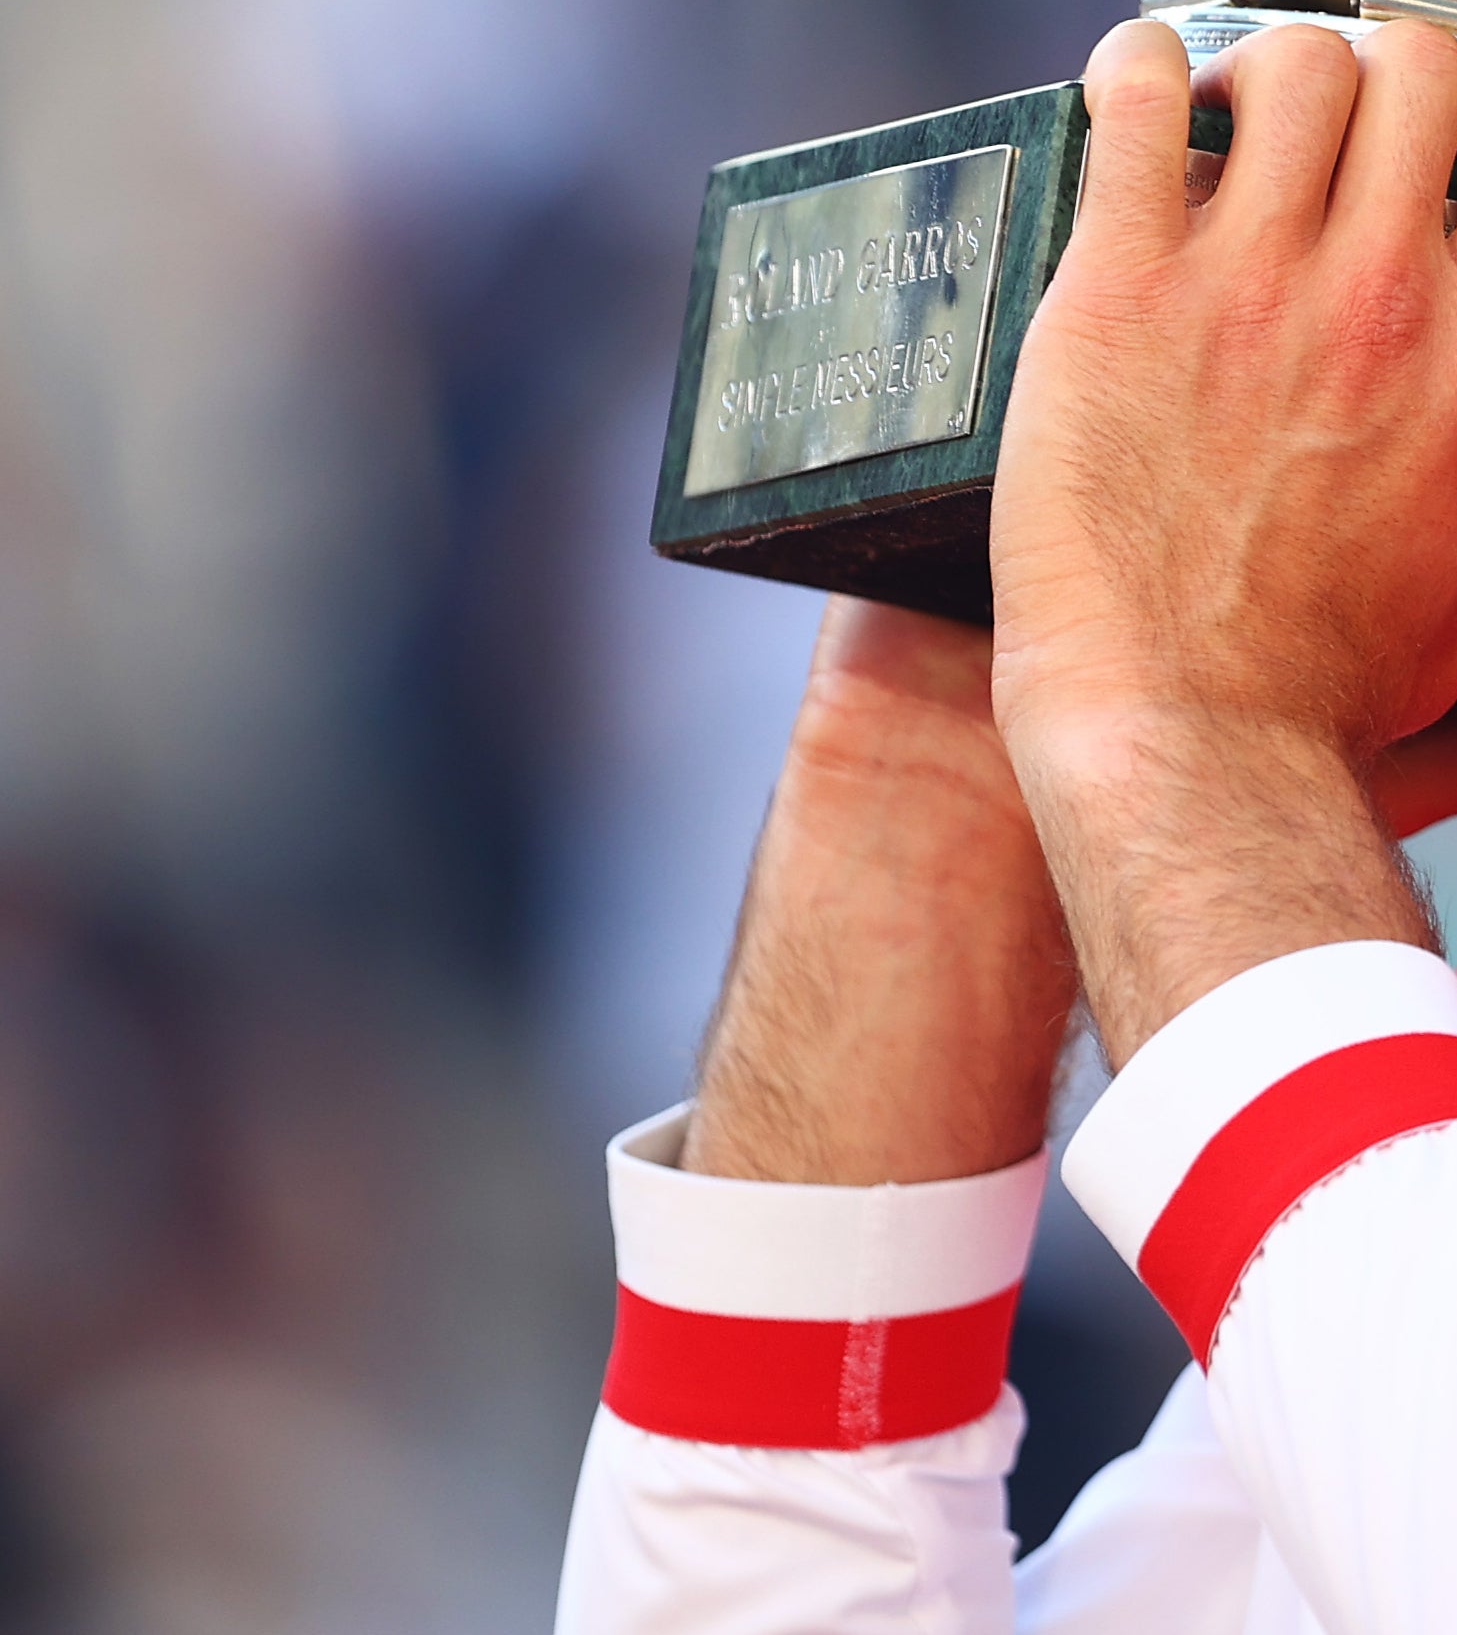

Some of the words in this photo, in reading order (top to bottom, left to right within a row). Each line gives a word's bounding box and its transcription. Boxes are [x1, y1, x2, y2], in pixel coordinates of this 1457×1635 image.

[856, 216, 982, 294] GARROS
[718, 364, 808, 432] SIMPLE
[811, 330, 953, 410] MESSIEURS
